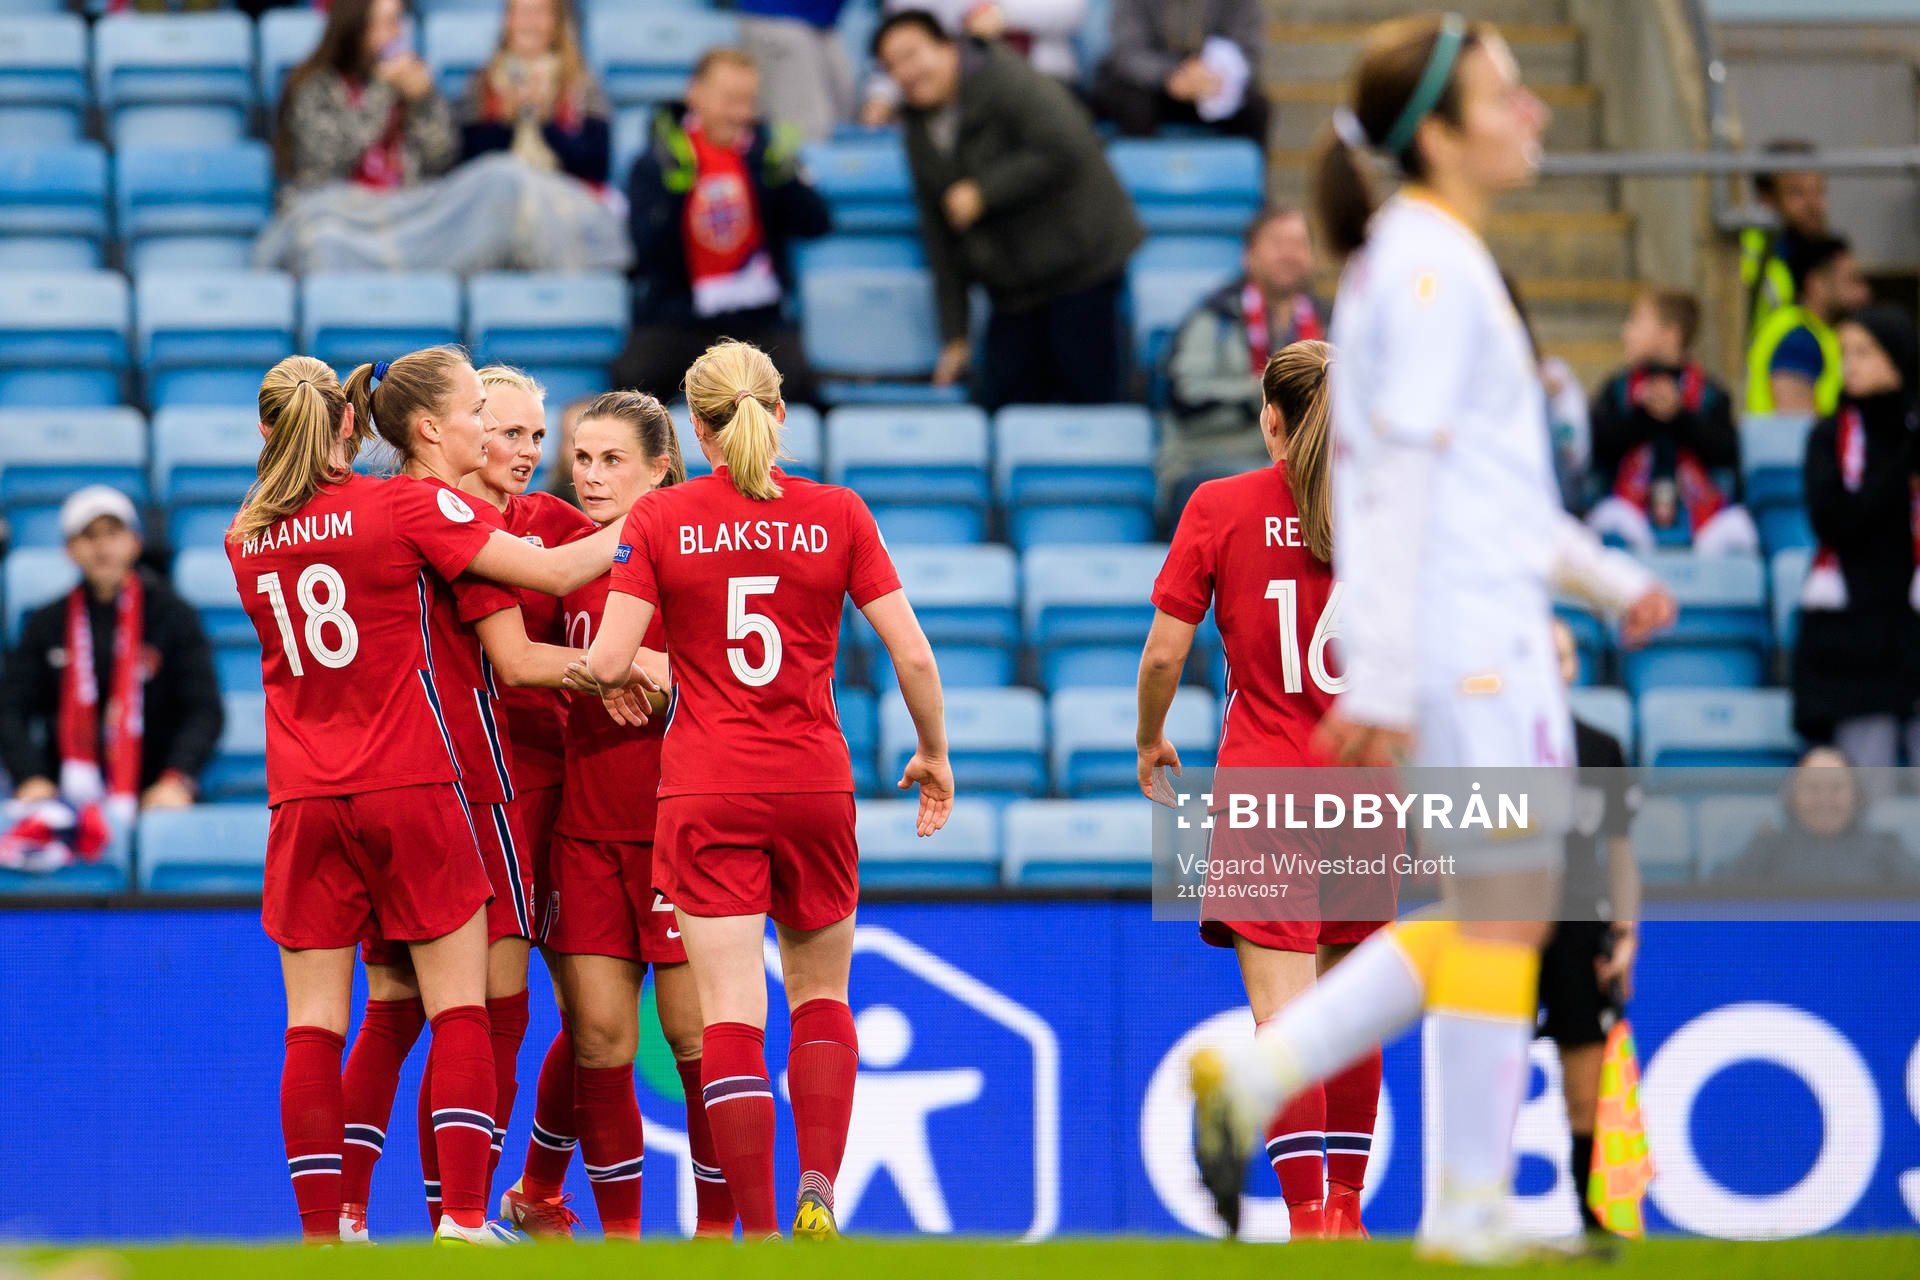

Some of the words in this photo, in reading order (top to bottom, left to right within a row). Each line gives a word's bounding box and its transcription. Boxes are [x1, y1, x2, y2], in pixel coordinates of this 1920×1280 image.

[241, 510, 353, 558] MAANUM
[679, 520, 828, 555] BLAKSTAD
[256, 563, 359, 677] 18
[726, 575, 783, 687] 5
[1263, 578, 1349, 695] 16
